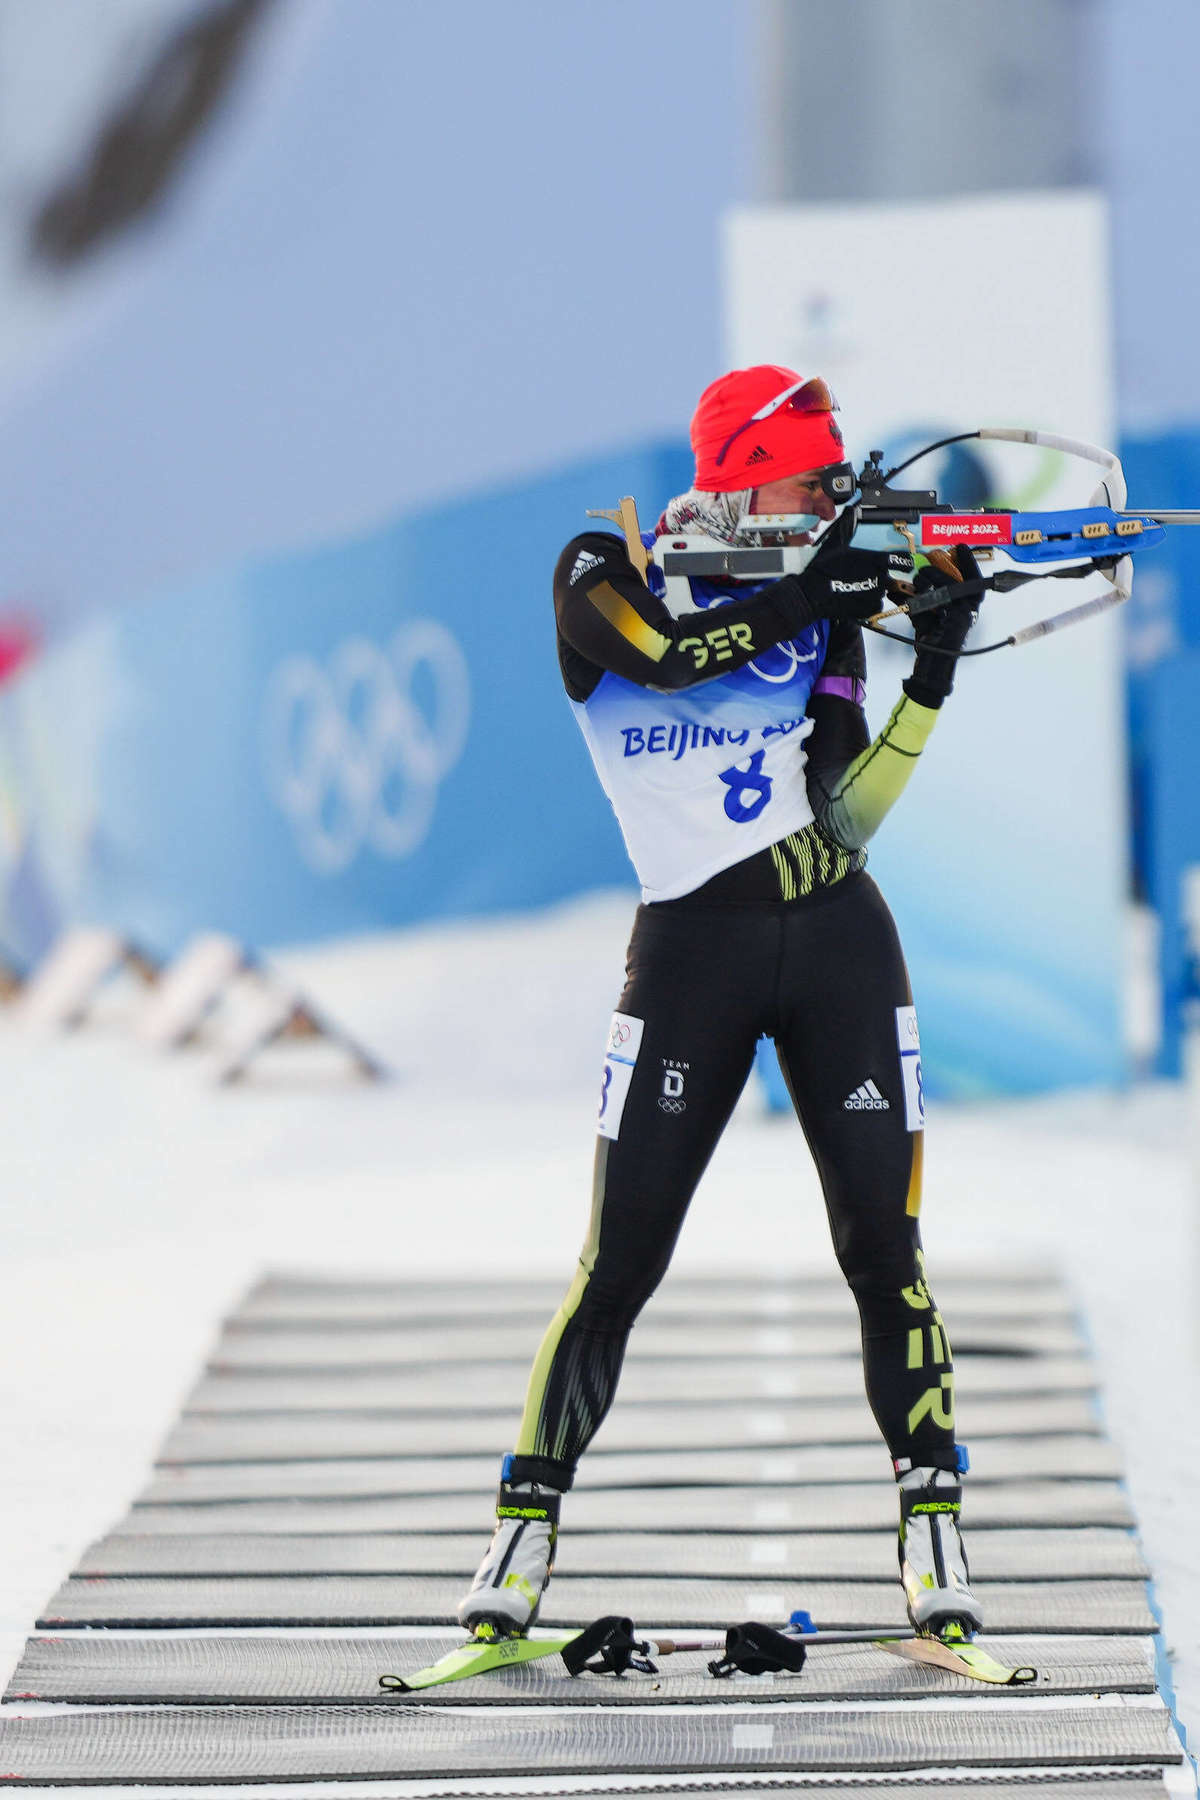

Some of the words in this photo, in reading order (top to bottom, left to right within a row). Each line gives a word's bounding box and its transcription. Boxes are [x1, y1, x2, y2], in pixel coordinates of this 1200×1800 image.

[932, 523, 970, 537] BEIJING
[972, 523, 1002, 535] 2022
[570, 555, 606, 586] adidas
[678, 622, 757, 669] GER
[718, 749, 773, 823] 8
[844, 1098, 890, 1110] adidas
